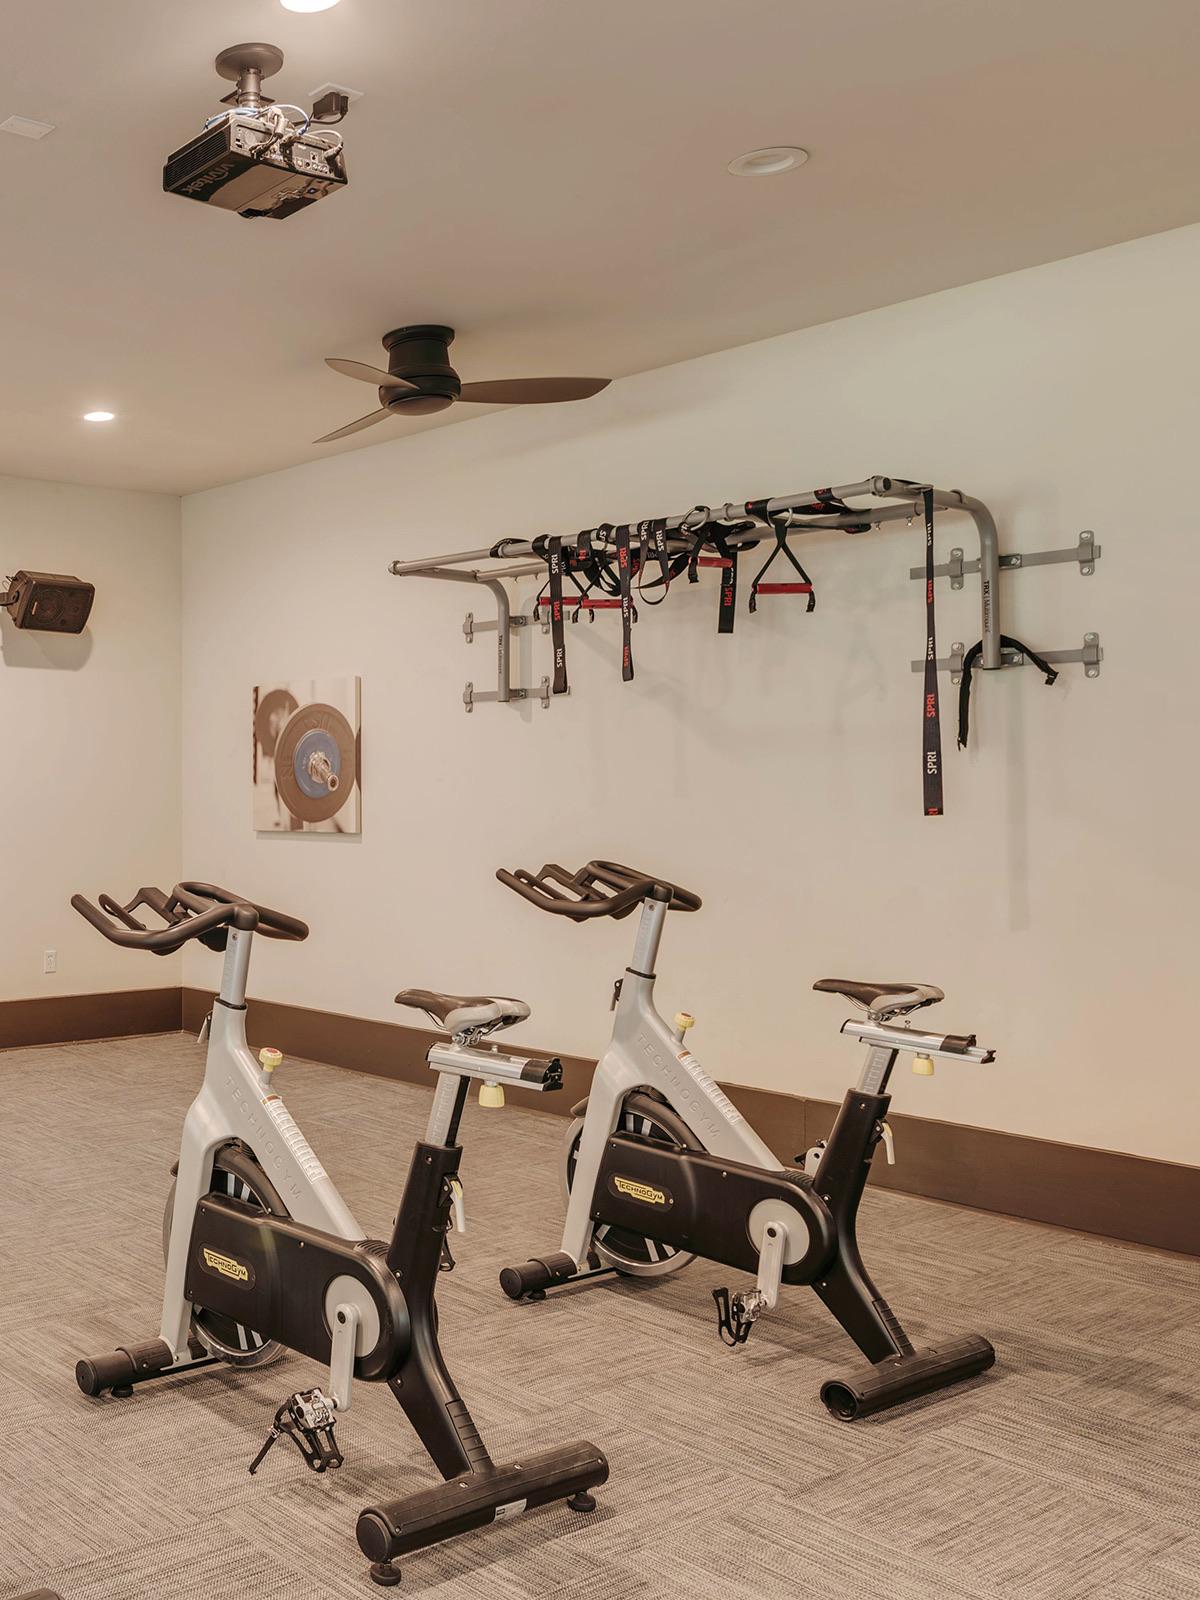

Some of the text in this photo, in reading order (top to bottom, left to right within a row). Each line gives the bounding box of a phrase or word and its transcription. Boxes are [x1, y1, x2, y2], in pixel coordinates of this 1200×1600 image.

[656, 529, 665, 552] SPRI
[551, 554, 559, 574] SPRI
[620, 547, 628, 568] SPRI
[724, 587, 733, 607] SPRI
[553, 601, 561, 621] SPRI
[927, 693, 936, 718] SPRI
[927, 750, 937, 775] SPRI
